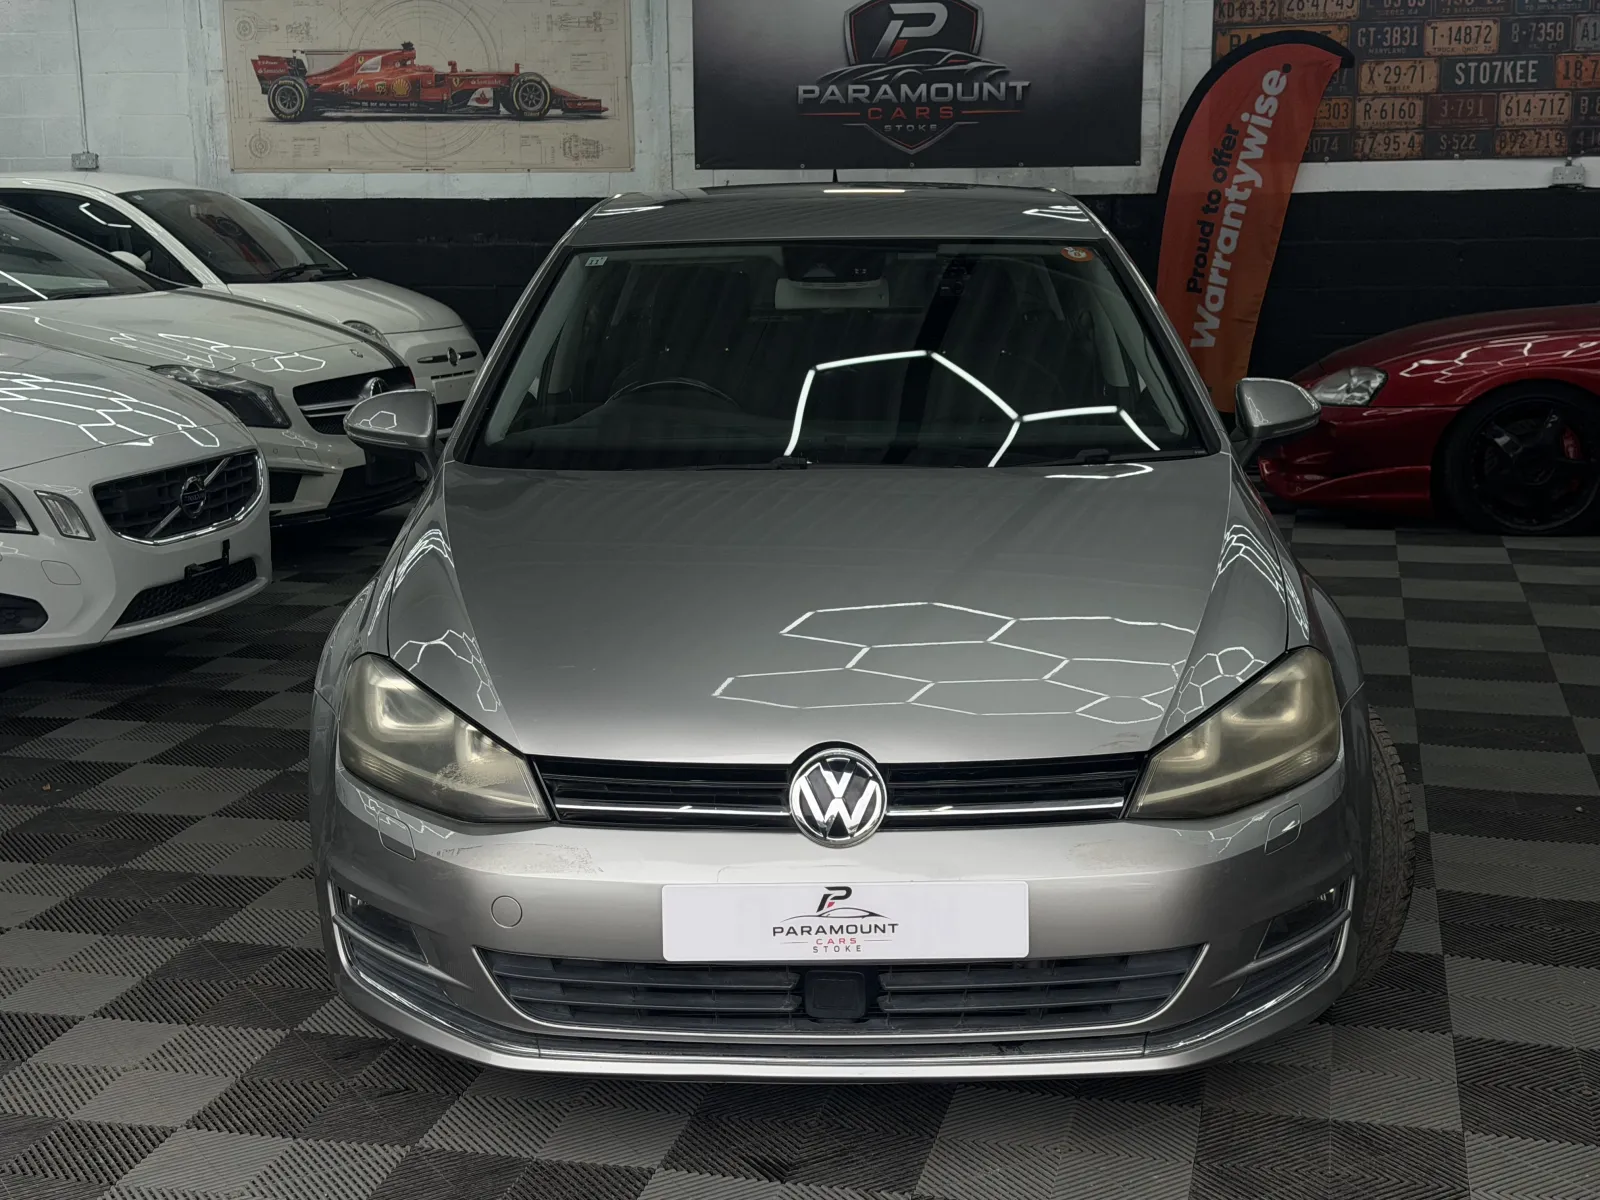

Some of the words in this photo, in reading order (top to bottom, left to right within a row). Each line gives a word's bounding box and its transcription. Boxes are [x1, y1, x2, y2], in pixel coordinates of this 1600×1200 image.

[797, 81, 1031, 104] PARAMOUNT
[867, 106, 955, 121] CARS
[884, 124, 938, 132] STOKE
[1211, 123, 1240, 187] offer
[1200, 190, 1222, 216] to
[1186, 219, 1215, 294] Proud
[772, 923, 899, 937] PARAMOUNT
[812, 945, 862, 953] STOKE
